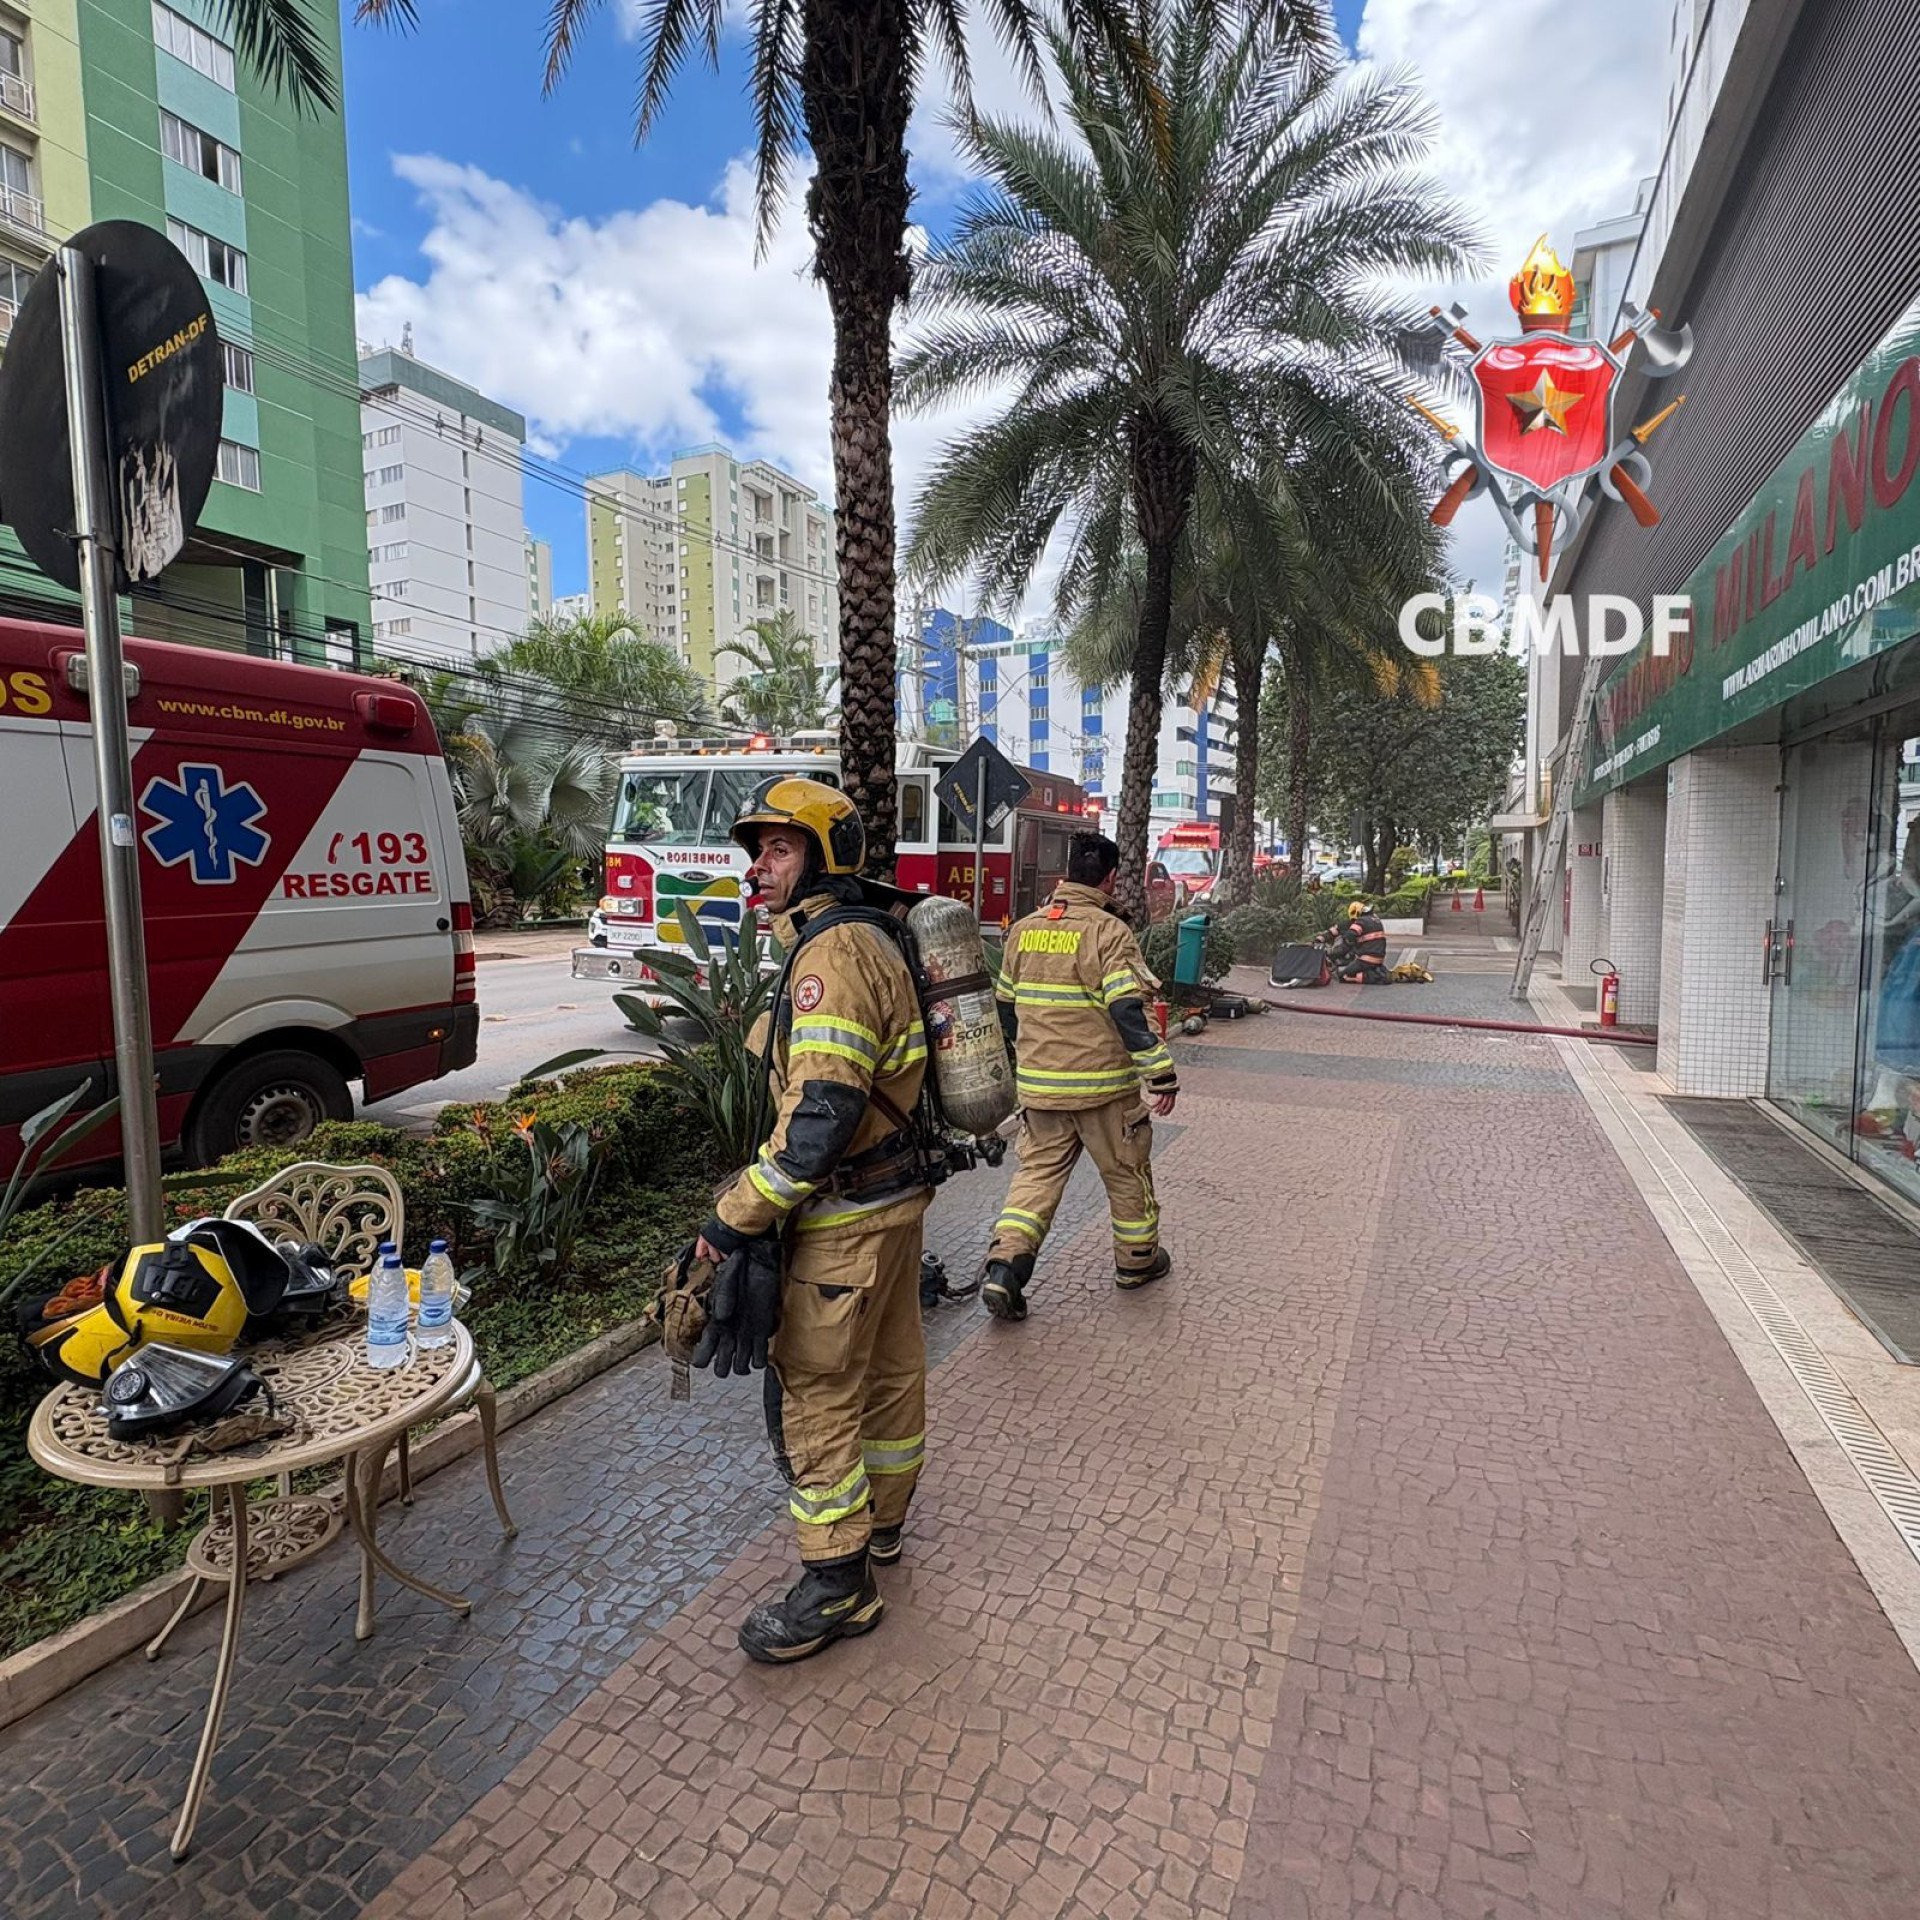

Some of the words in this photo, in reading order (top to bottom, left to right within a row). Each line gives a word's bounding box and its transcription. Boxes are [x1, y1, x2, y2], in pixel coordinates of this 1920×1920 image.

[127, 313, 208, 384] DETRAN-DF
[1711, 354, 1920, 652] MILANO
[0, 671, 52, 714] S
[157, 699, 346, 732] www.cbm.df.gov.br
[351, 832, 428, 864] 193
[283, 871, 432, 898] RESGATE
[956, 1023, 994, 1042] SCOTT
